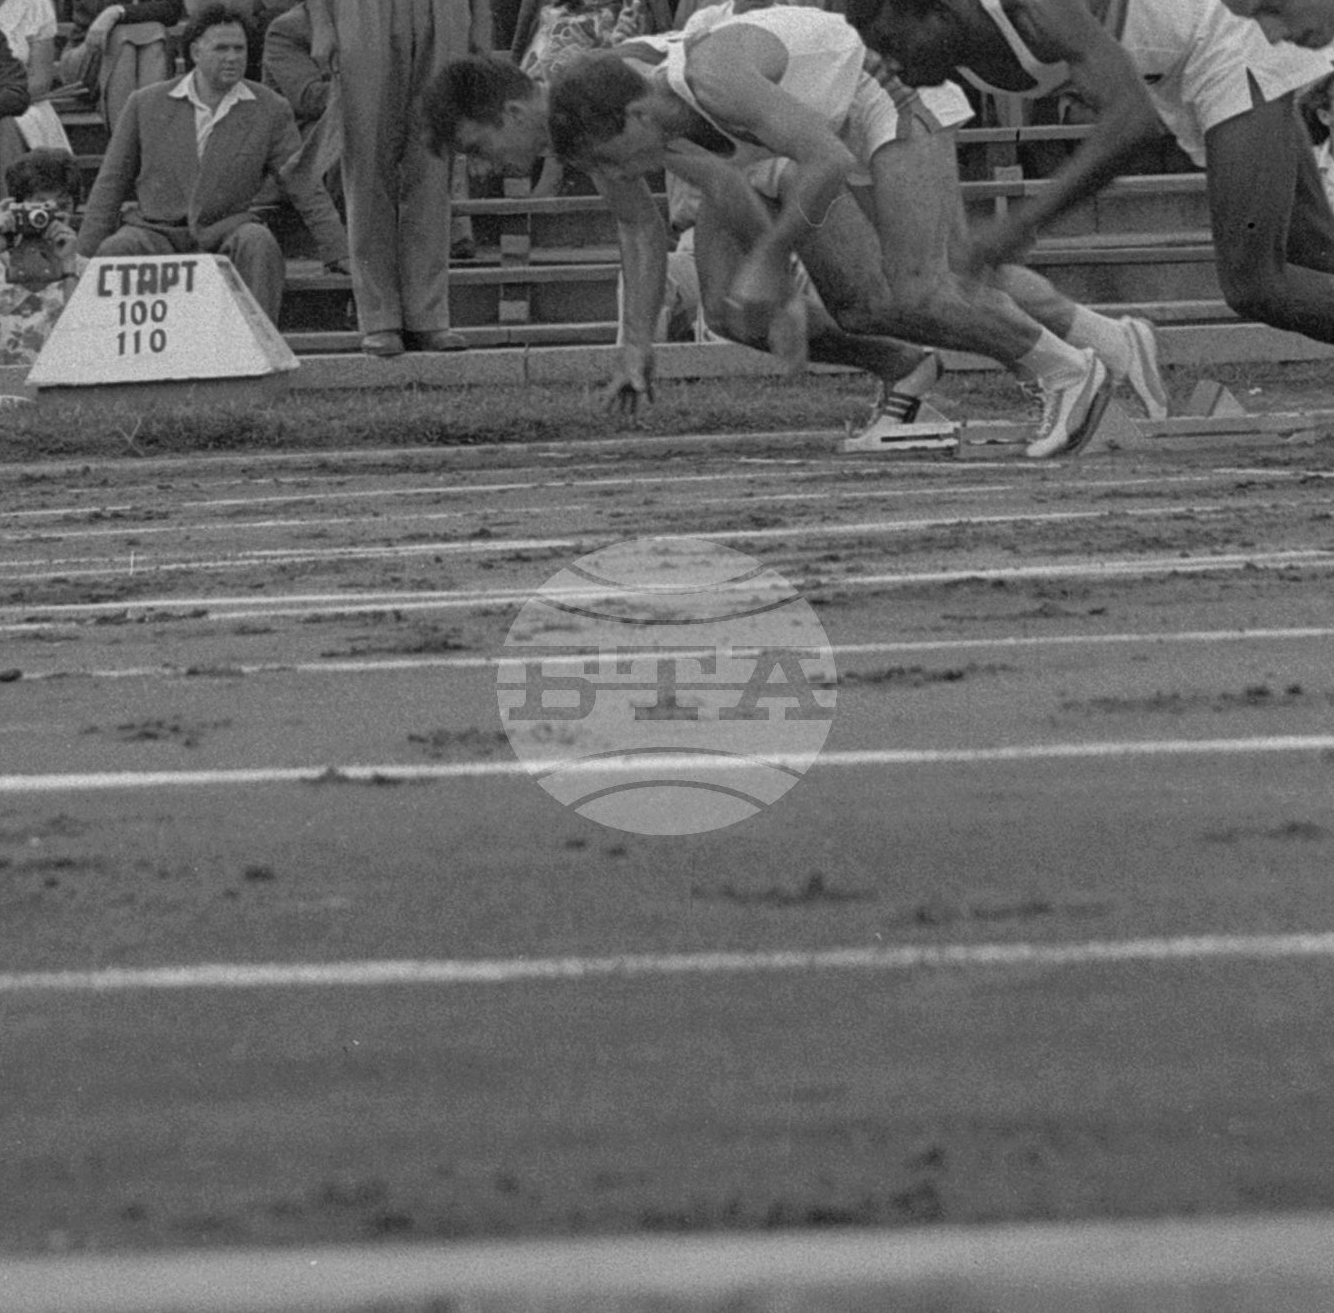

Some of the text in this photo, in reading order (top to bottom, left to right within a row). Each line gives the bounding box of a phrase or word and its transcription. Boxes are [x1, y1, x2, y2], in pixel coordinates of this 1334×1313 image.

[97, 261, 198, 297] СТАРТ
[118, 299, 167, 326] 100
[117, 329, 167, 356] 110
